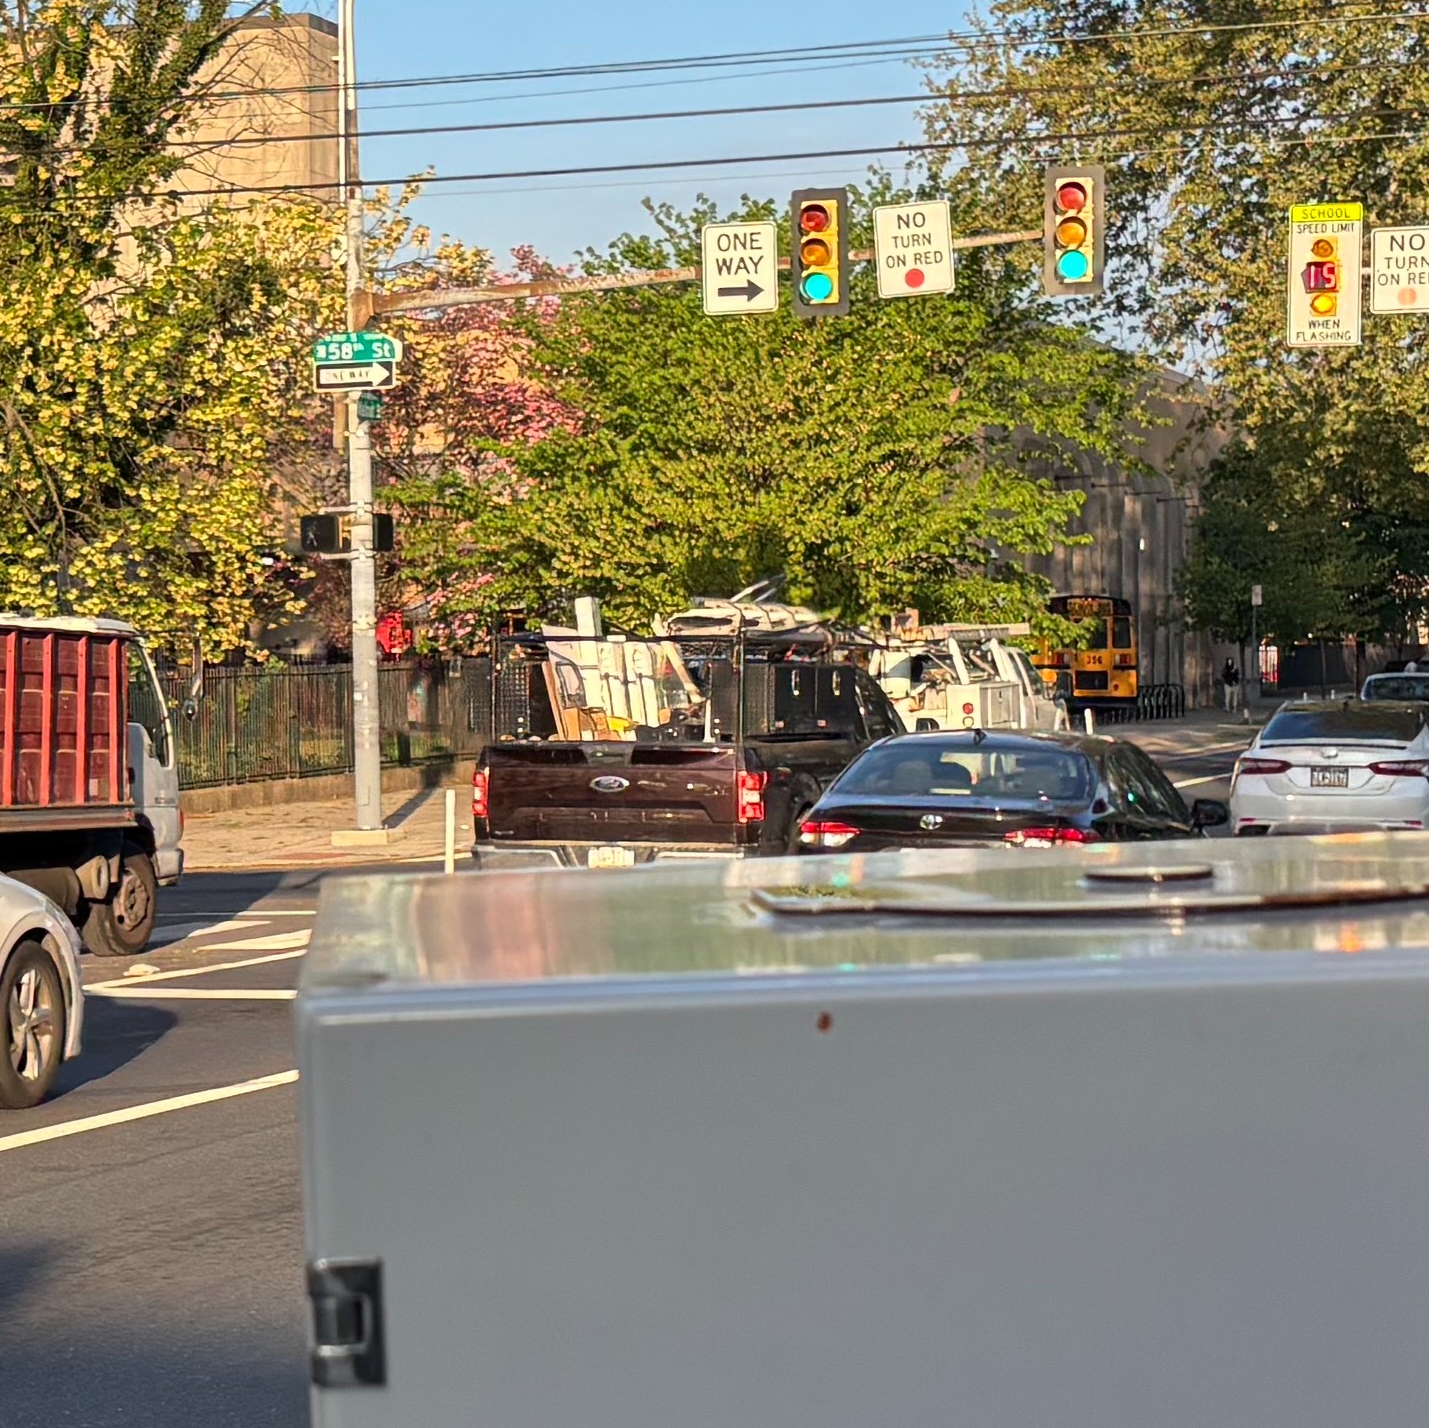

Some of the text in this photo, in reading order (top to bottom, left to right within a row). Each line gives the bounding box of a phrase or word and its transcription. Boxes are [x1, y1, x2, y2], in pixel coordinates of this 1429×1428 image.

[896, 212, 926, 231] NO
[1301, 208, 1350, 220] SCHOOL
[1296, 223, 1327, 234] SPEED
[1331, 223, 1355, 233] LIMIT
[716, 231, 762, 252] ONE
[891, 232, 932, 249] TURN
[1390, 233, 1426, 252] NO
[715, 255, 765, 276] WAY
[886, 249, 944, 270] ON RED
[1310, 262, 1336, 289] 15
[1377, 273, 1400, 286] ON
[1308, 319, 1341, 330] WHEN
[1296, 331, 1352, 342] FLASHING
[371, 342, 391, 359] St
